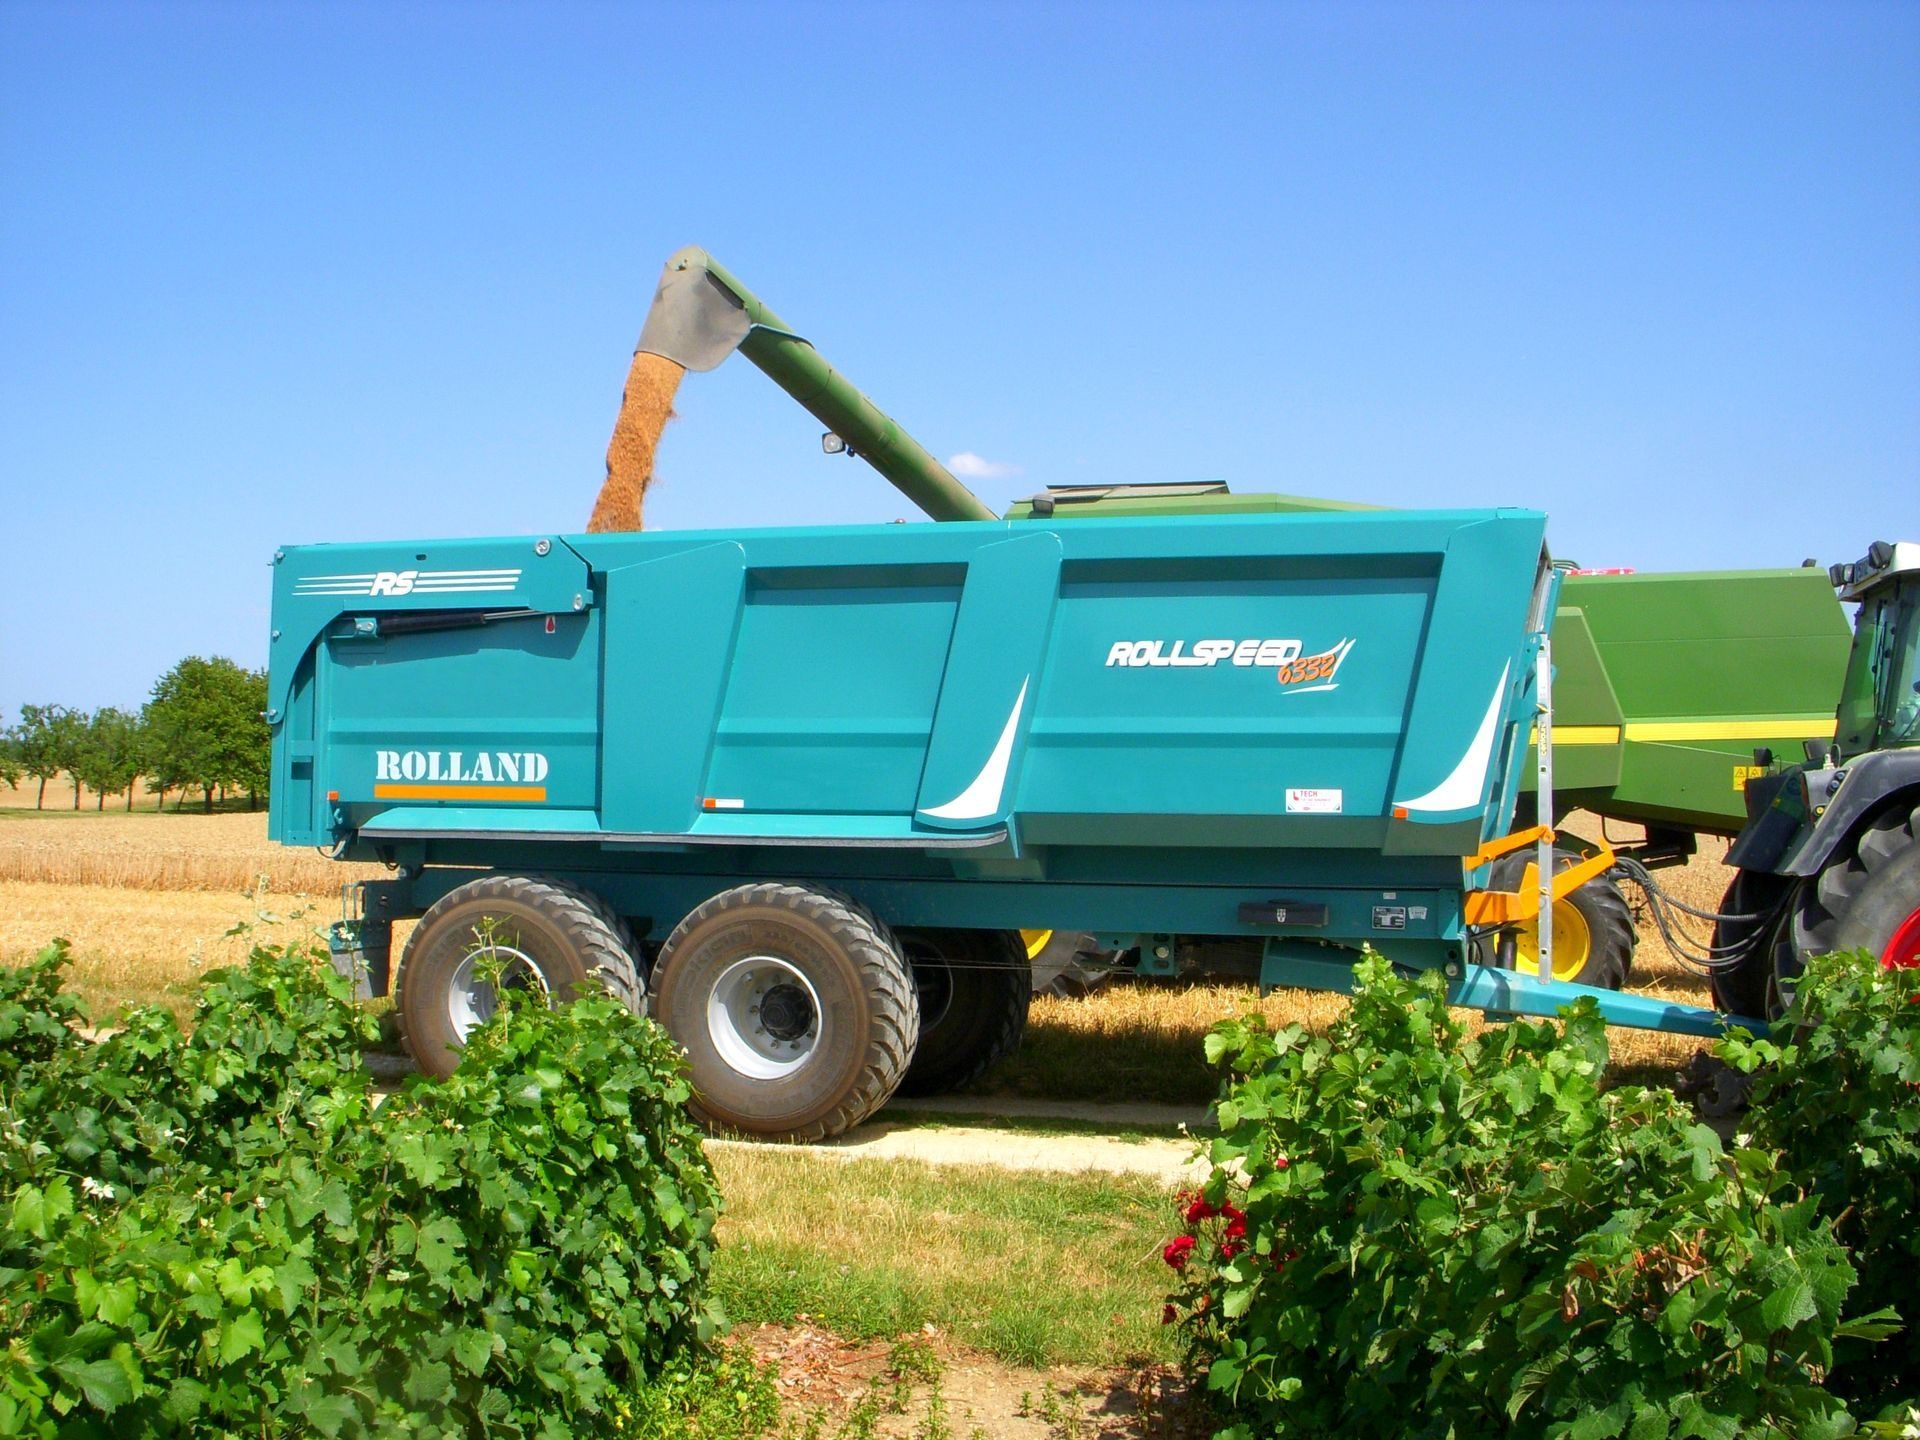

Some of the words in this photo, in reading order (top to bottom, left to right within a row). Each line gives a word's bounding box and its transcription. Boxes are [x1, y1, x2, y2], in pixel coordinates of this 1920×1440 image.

[370, 571, 418, 596] RS
[1105, 640, 1303, 667] ROLLSPEED
[1278, 654, 1336, 685] 6332
[376, 751, 548, 782] ROLLAND
[1300, 790, 1318, 798] TECH
